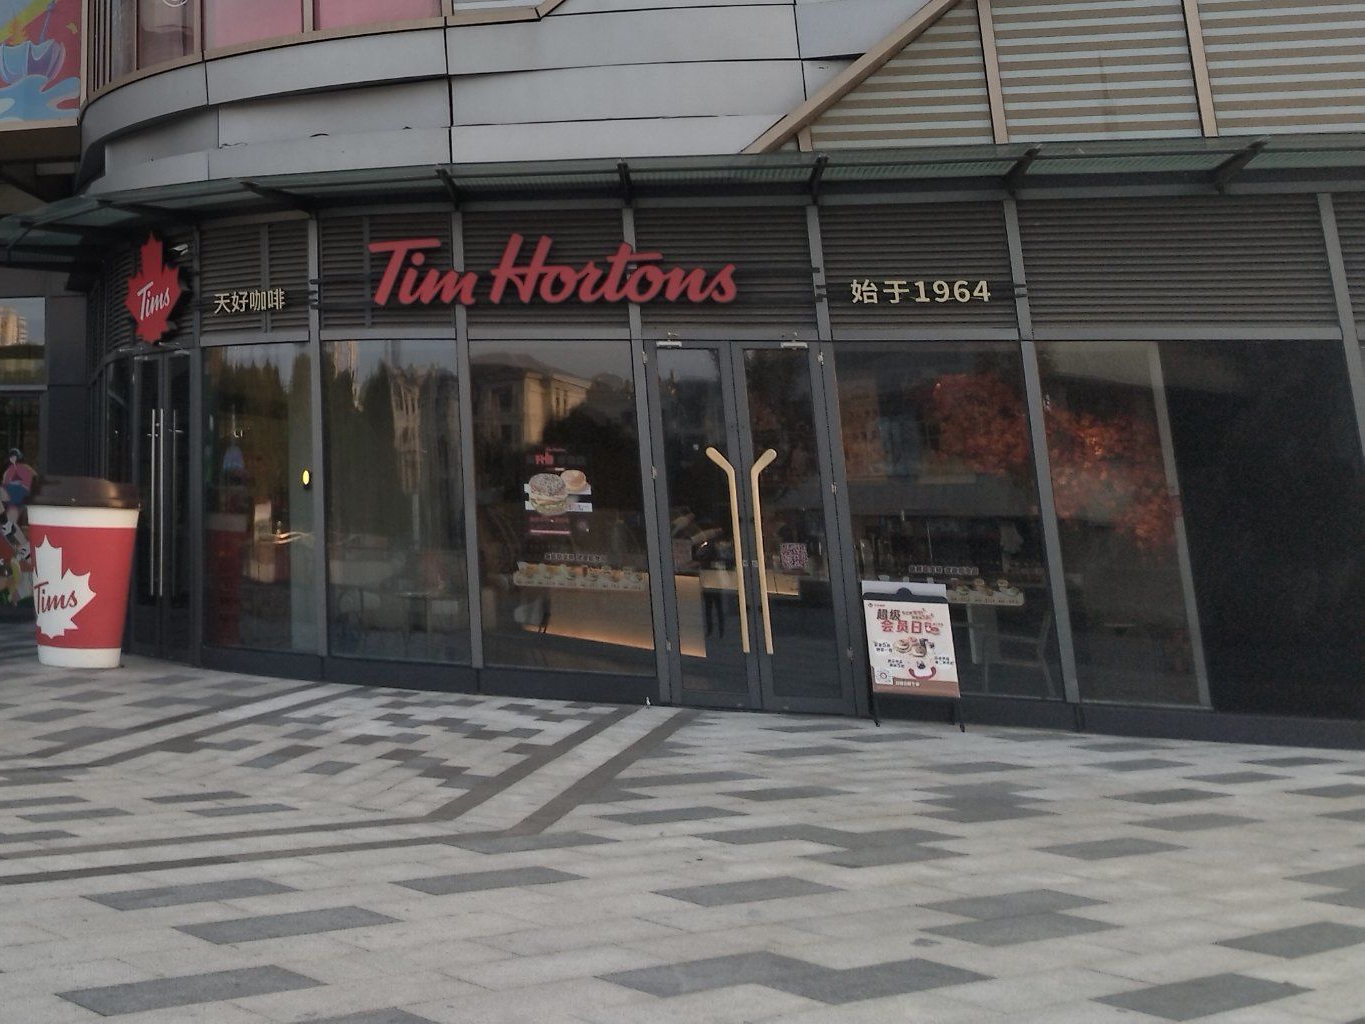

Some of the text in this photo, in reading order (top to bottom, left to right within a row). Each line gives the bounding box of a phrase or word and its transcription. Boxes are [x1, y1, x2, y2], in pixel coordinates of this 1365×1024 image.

[368, 232, 738, 306] Tim Hortons
[136, 280, 170, 321] Tims
[214, 288, 286, 314] 天好咖啡
[849, 278, 991, 304] 始于1964
[34, 581, 78, 615] Tims
